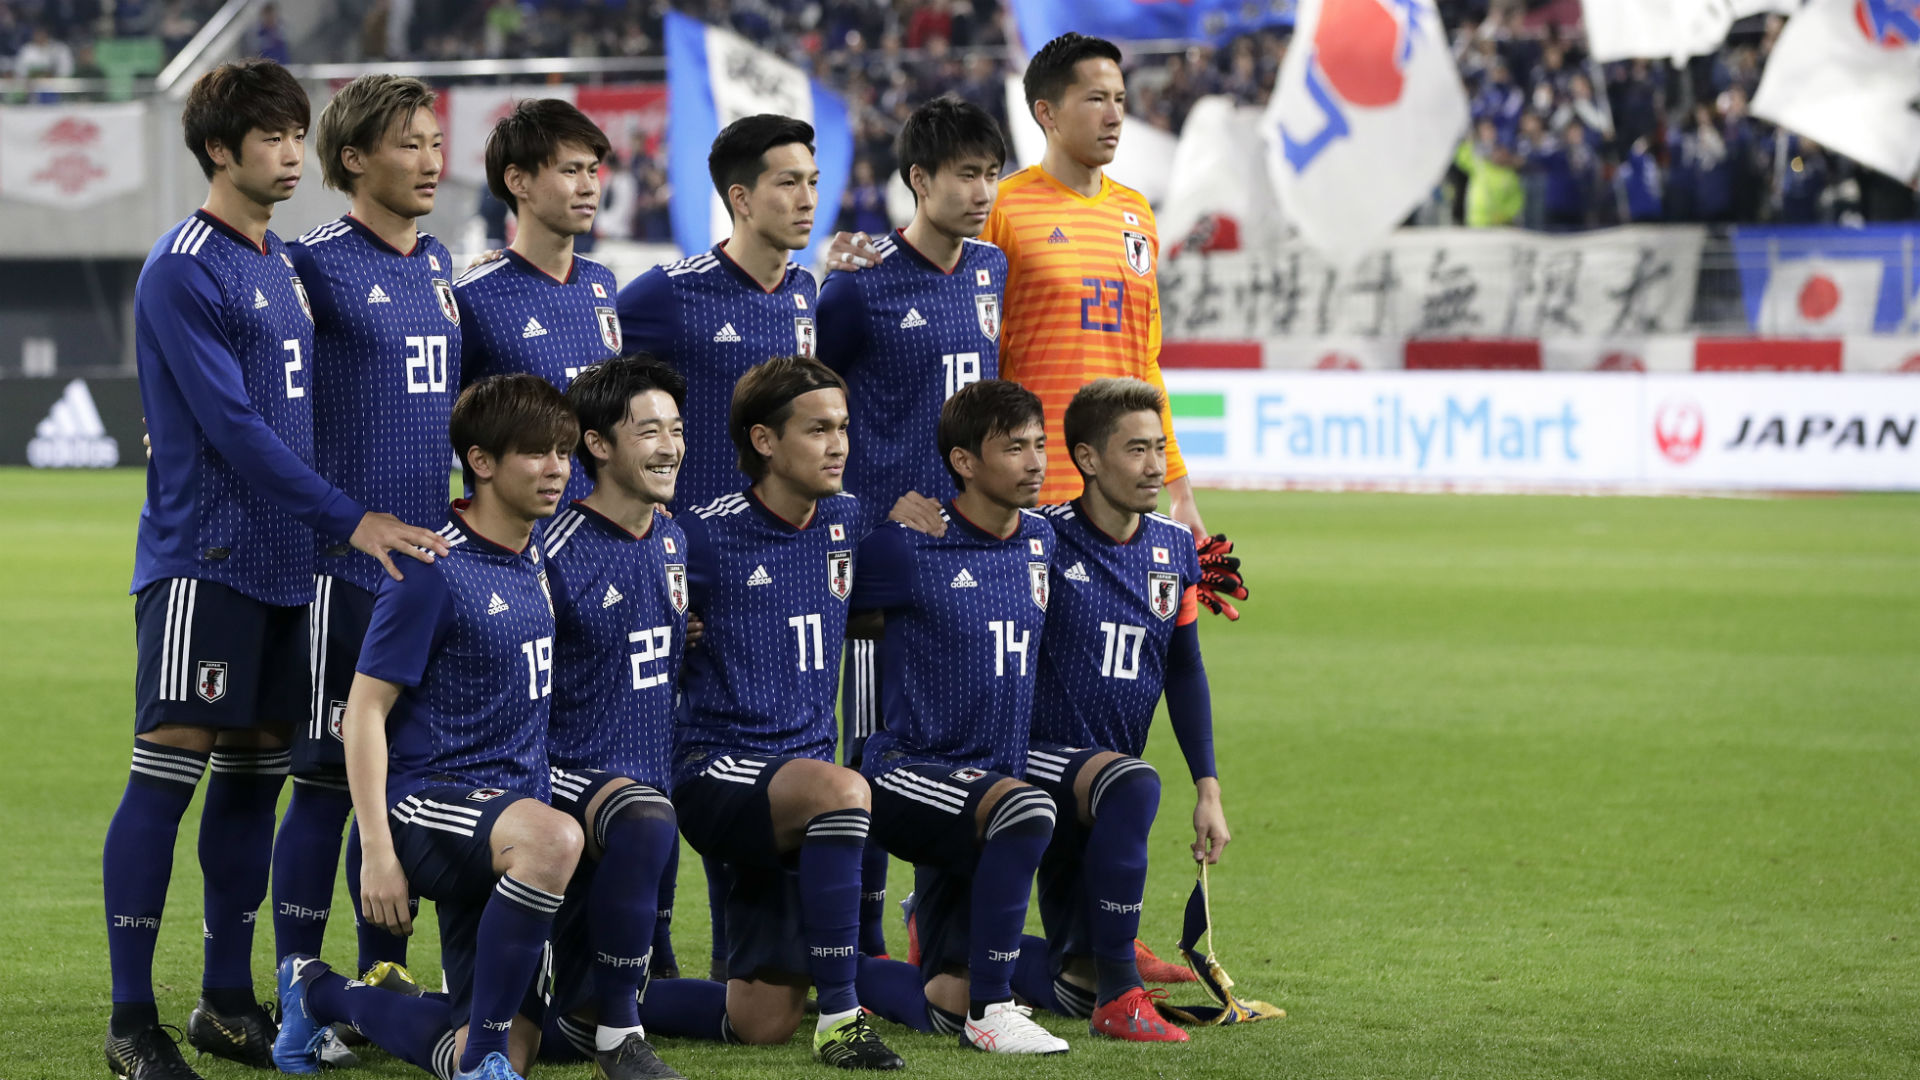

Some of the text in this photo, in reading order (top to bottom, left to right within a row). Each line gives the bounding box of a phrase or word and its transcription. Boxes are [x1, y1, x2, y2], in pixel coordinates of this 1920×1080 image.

[1082, 278, 1124, 333] 23
[522, 327, 548, 339] adidas
[899, 318, 928, 329] adidas
[713, 332, 742, 343] adidas
[283, 338, 304, 398] 2
[405, 336, 447, 393] 20
[1254, 393, 1580, 470] FamilyMart
[1726, 414, 1916, 449] JAPAN
[746, 576, 772, 587] adidas
[950, 579, 978, 589] adidas
[1063, 571, 1090, 583] adidas
[487, 602, 510, 616] adidas
[602, 592, 624, 609] adidas
[788, 613, 825, 672] 11
[988, 620, 1030, 677] 14
[1099, 621, 1147, 681] 10
[522, 636, 552, 700] 19
[628, 625, 672, 690] 22
[597, 951, 648, 968] JAPAN
[810, 945, 854, 958] JAPAN
